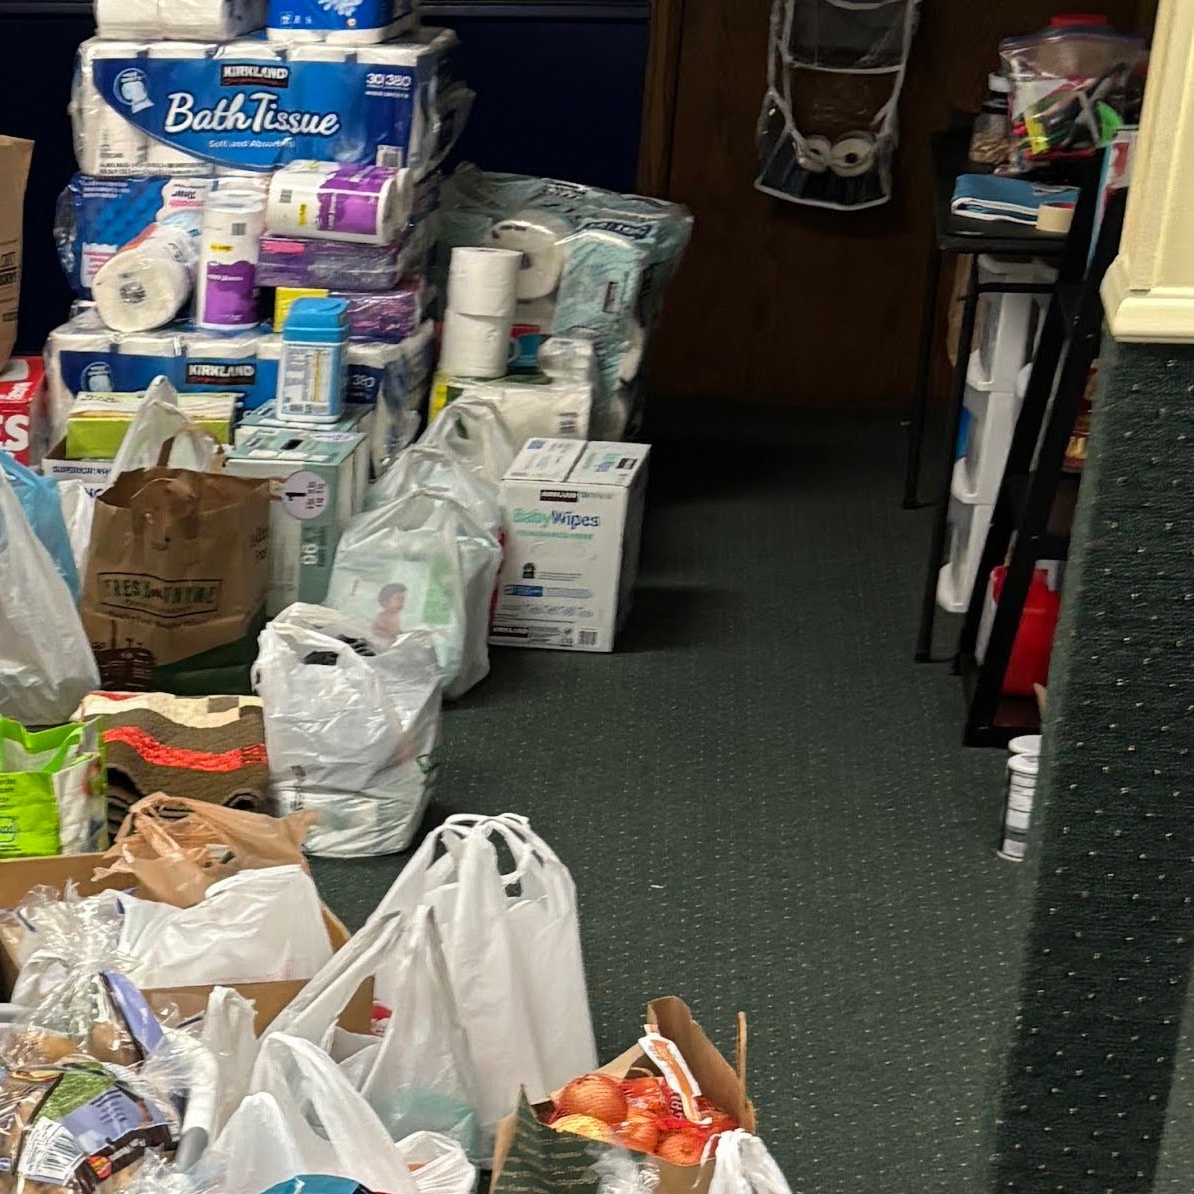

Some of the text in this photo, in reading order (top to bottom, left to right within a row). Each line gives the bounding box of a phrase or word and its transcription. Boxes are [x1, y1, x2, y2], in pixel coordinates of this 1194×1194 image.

[222, 65, 289, 81] KIRKLAND
[164, 92, 340, 135] Bath Tissue
[189, 364, 256, 379] KIRKLAND
